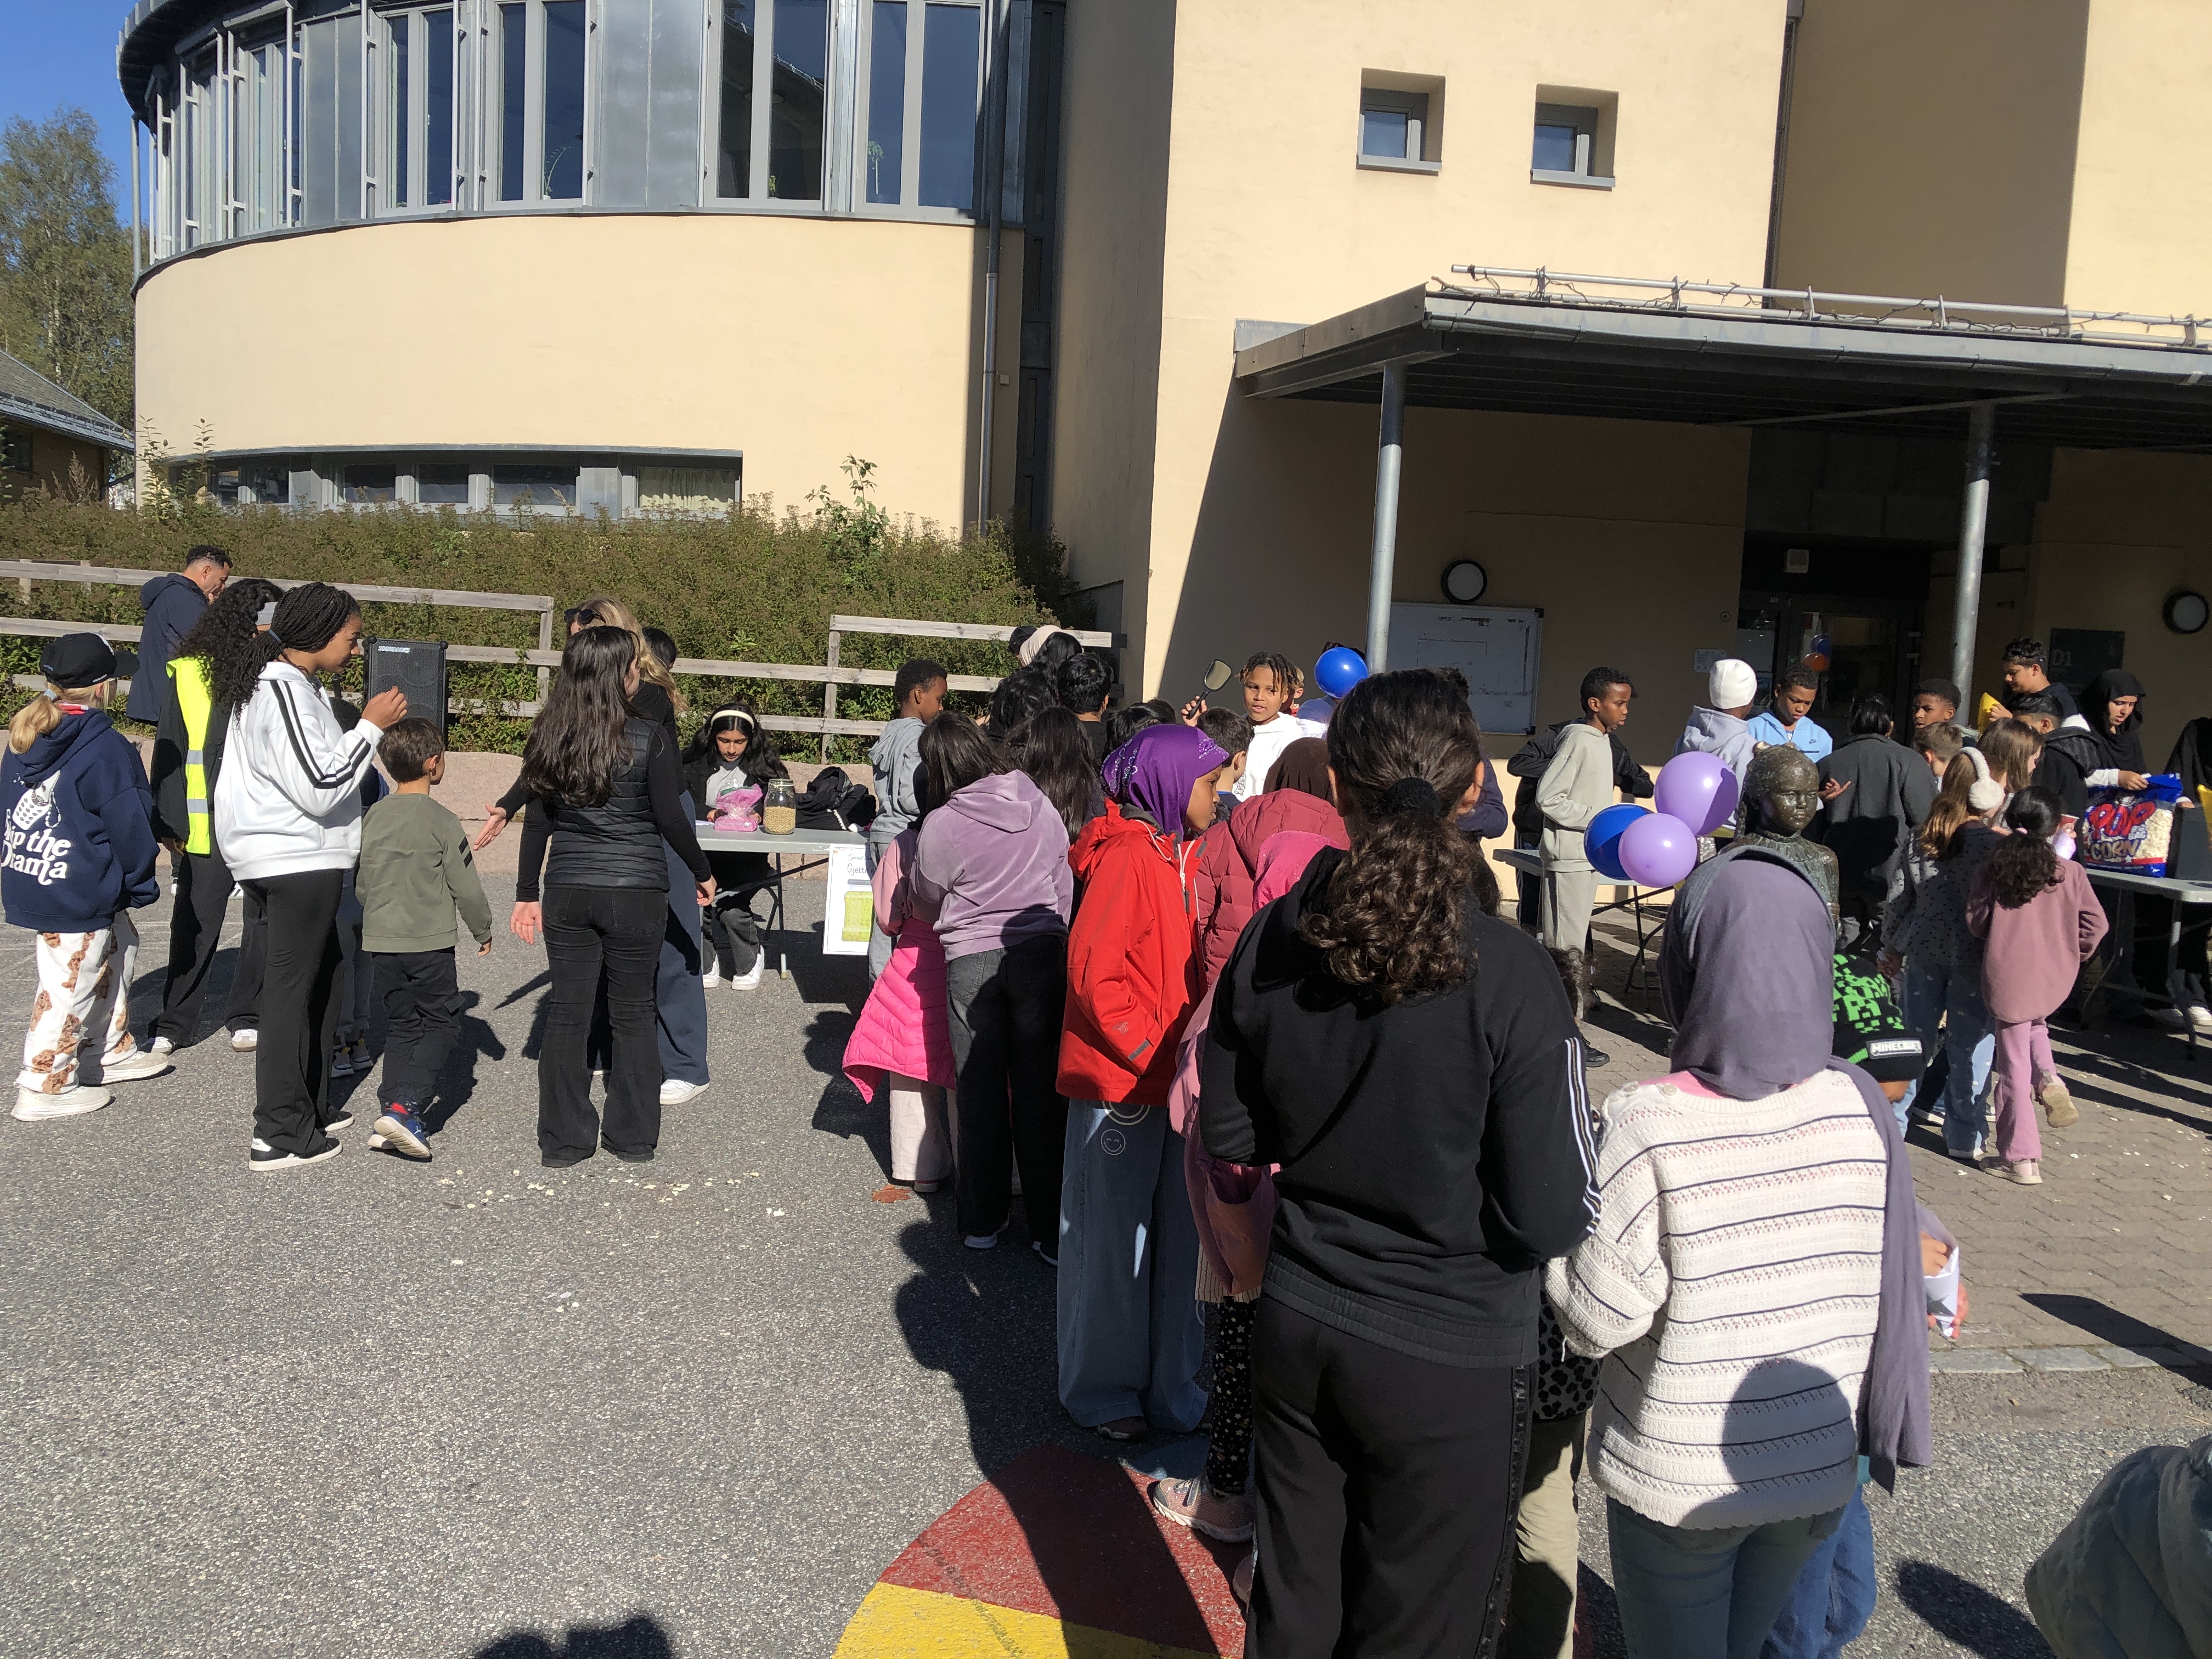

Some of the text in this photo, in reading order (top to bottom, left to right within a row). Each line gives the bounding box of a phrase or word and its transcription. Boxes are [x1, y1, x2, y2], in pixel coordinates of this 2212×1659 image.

[2088, 800, 2157, 840] POP
[26, 828, 71, 861] the
[2090, 839, 2141, 861] CORN
[1, 839, 67, 885] Drama
[1871, 1042, 1922, 1053] MINEC
